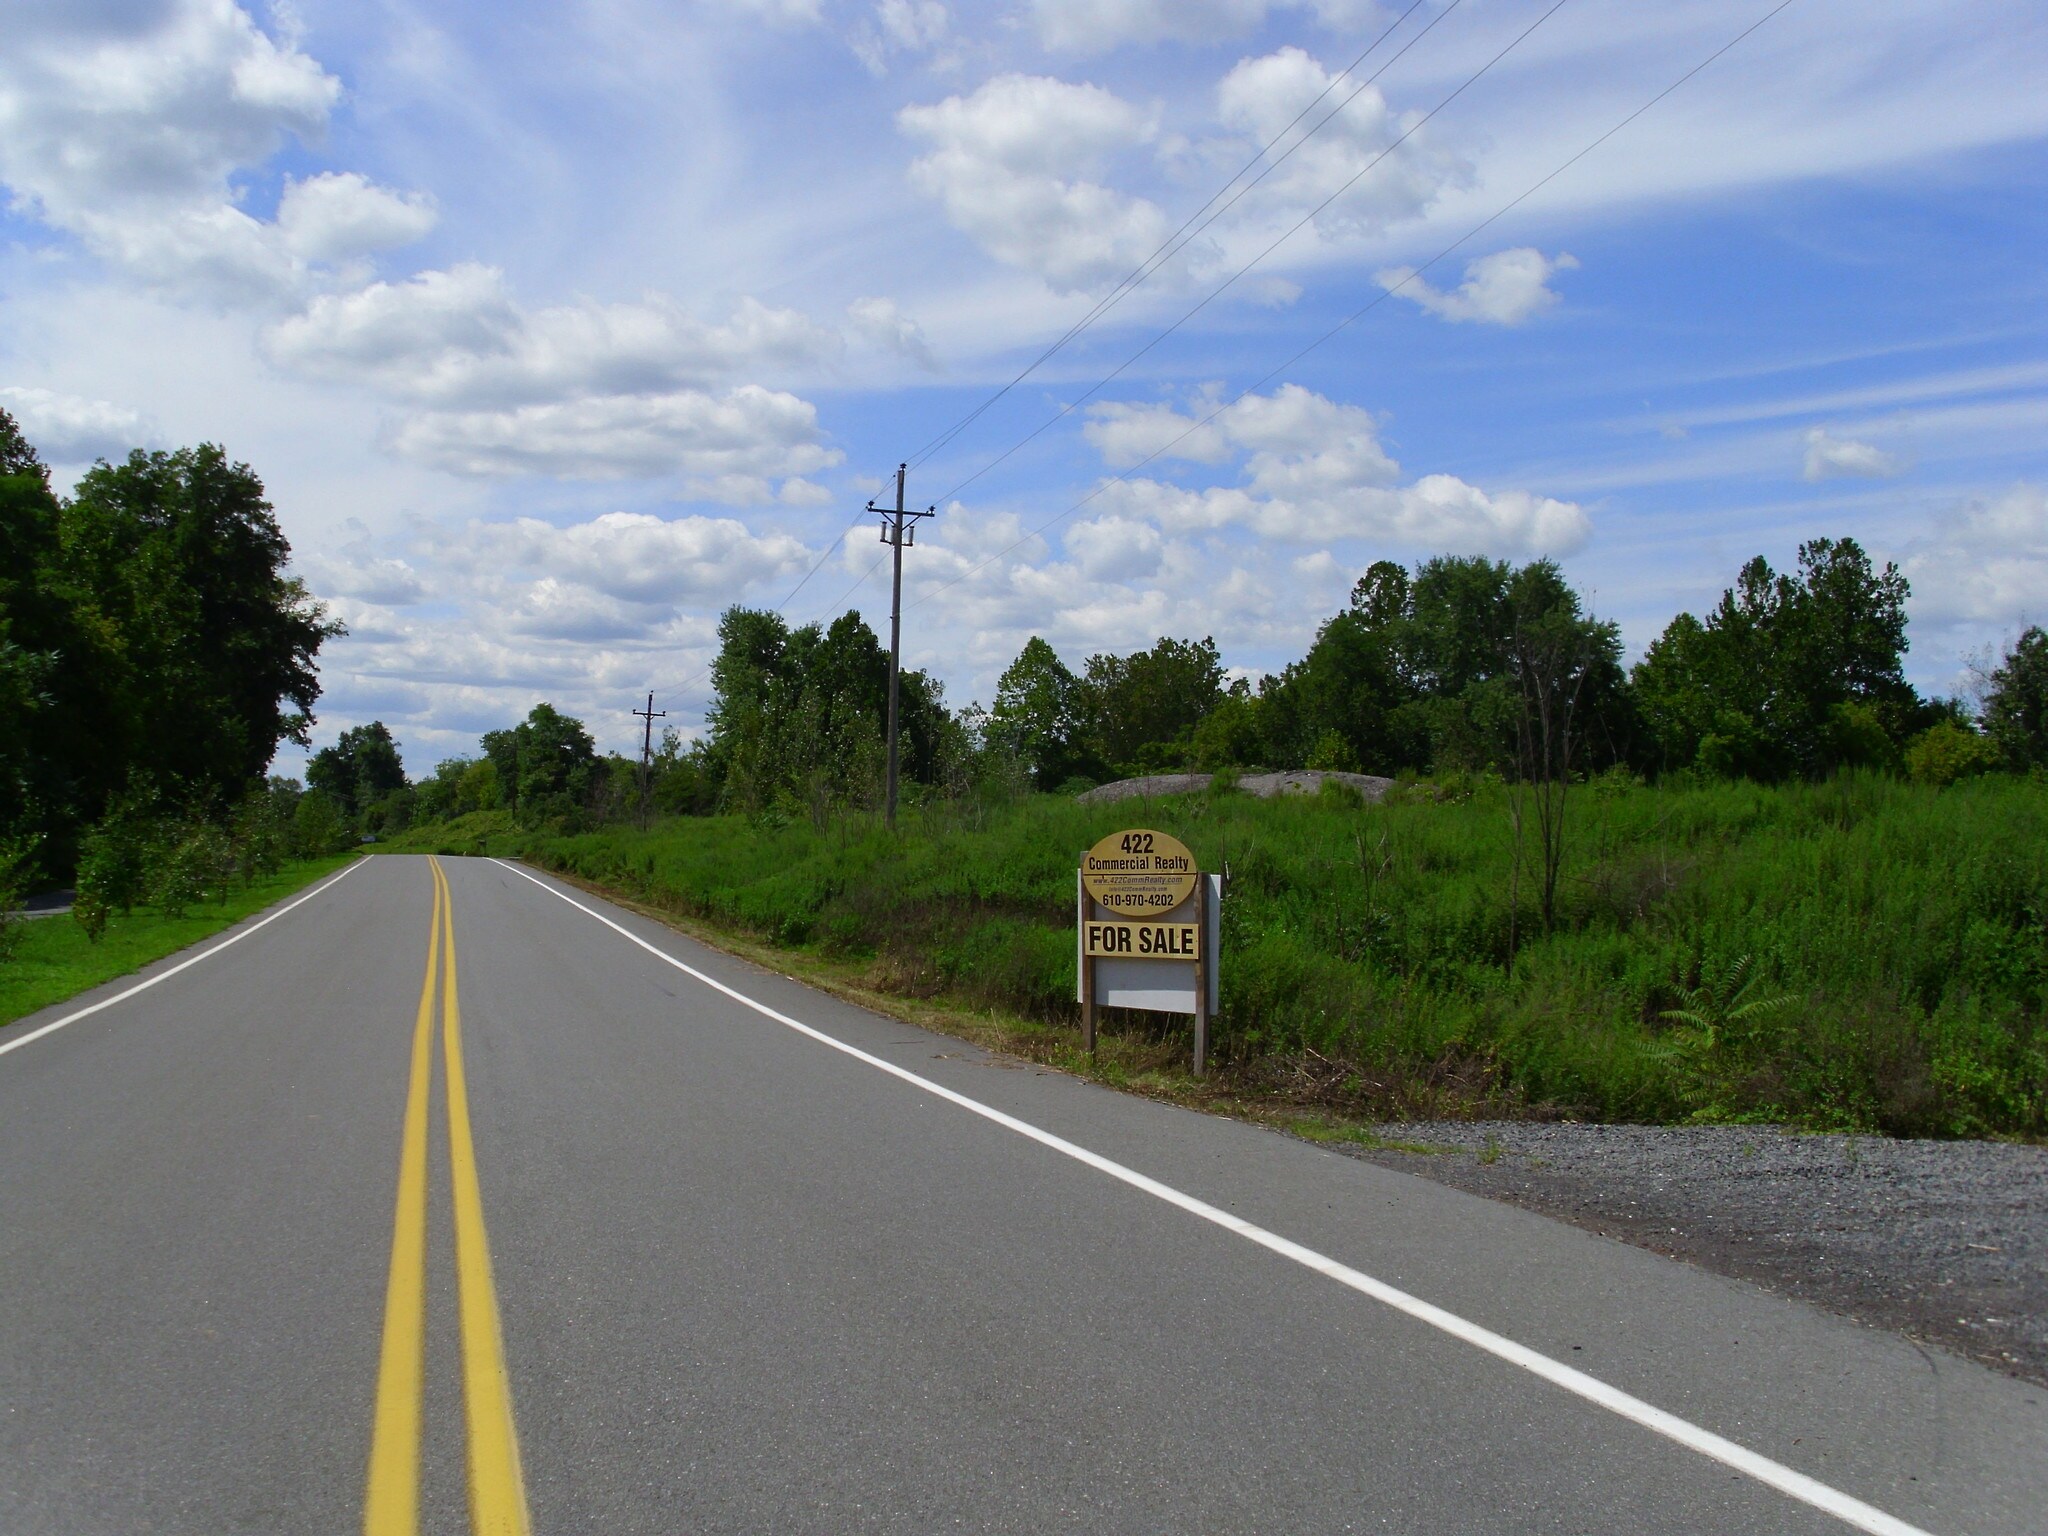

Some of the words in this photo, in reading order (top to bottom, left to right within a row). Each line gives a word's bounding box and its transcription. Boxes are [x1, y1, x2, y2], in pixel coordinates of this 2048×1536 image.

[1121, 834, 1154, 854] 422
[1089, 856, 1149, 870] Commercial
[1155, 856, 1189, 871] Realty
[1093, 876, 1183, 885] www.422CommRealty.com
[1103, 894, 1174, 906] 610-970-4202
[1089, 926, 1132, 953] FOR
[1139, 927, 1194, 954] SALE
